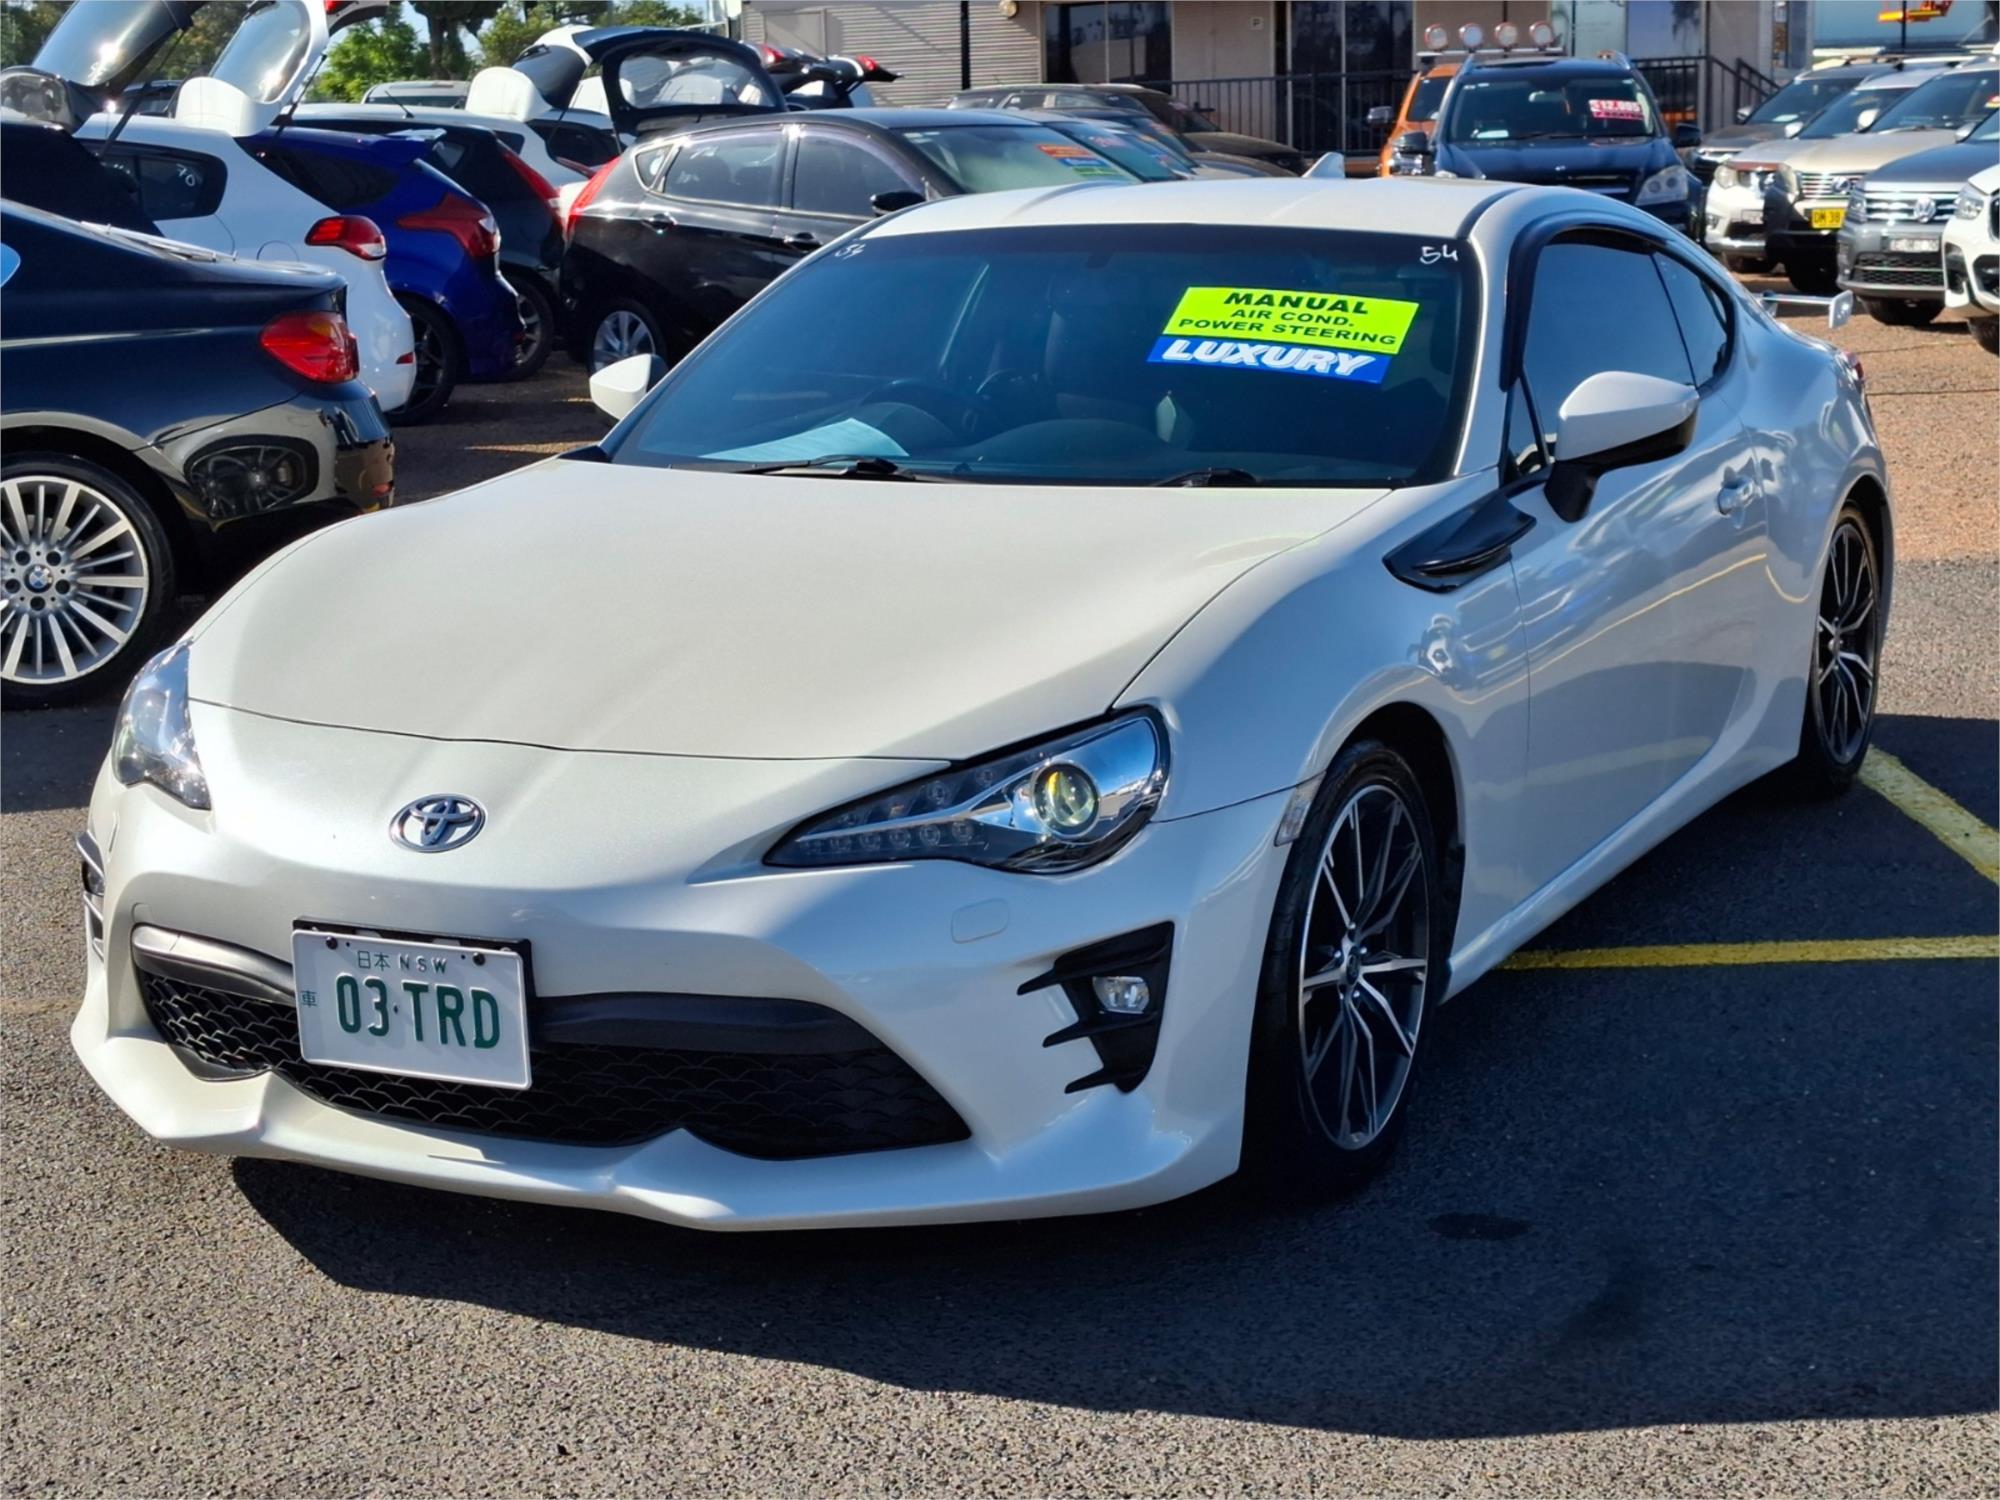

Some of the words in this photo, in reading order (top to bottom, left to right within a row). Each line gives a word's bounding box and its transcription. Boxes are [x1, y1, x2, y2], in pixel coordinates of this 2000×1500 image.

[1420, 244, 1458, 264] 54
[1224, 292, 1369, 315] MANUAL
[1231, 309, 1272, 320] AIR
[1280, 311, 1355, 327] COND.
[1178, 318, 1264, 331] POWER
[1271, 324, 1398, 345] STEERING
[1161, 339, 1376, 376] LUXURY
[357, 950, 390, 972] 日本
[398, 953, 448, 974] NSW
